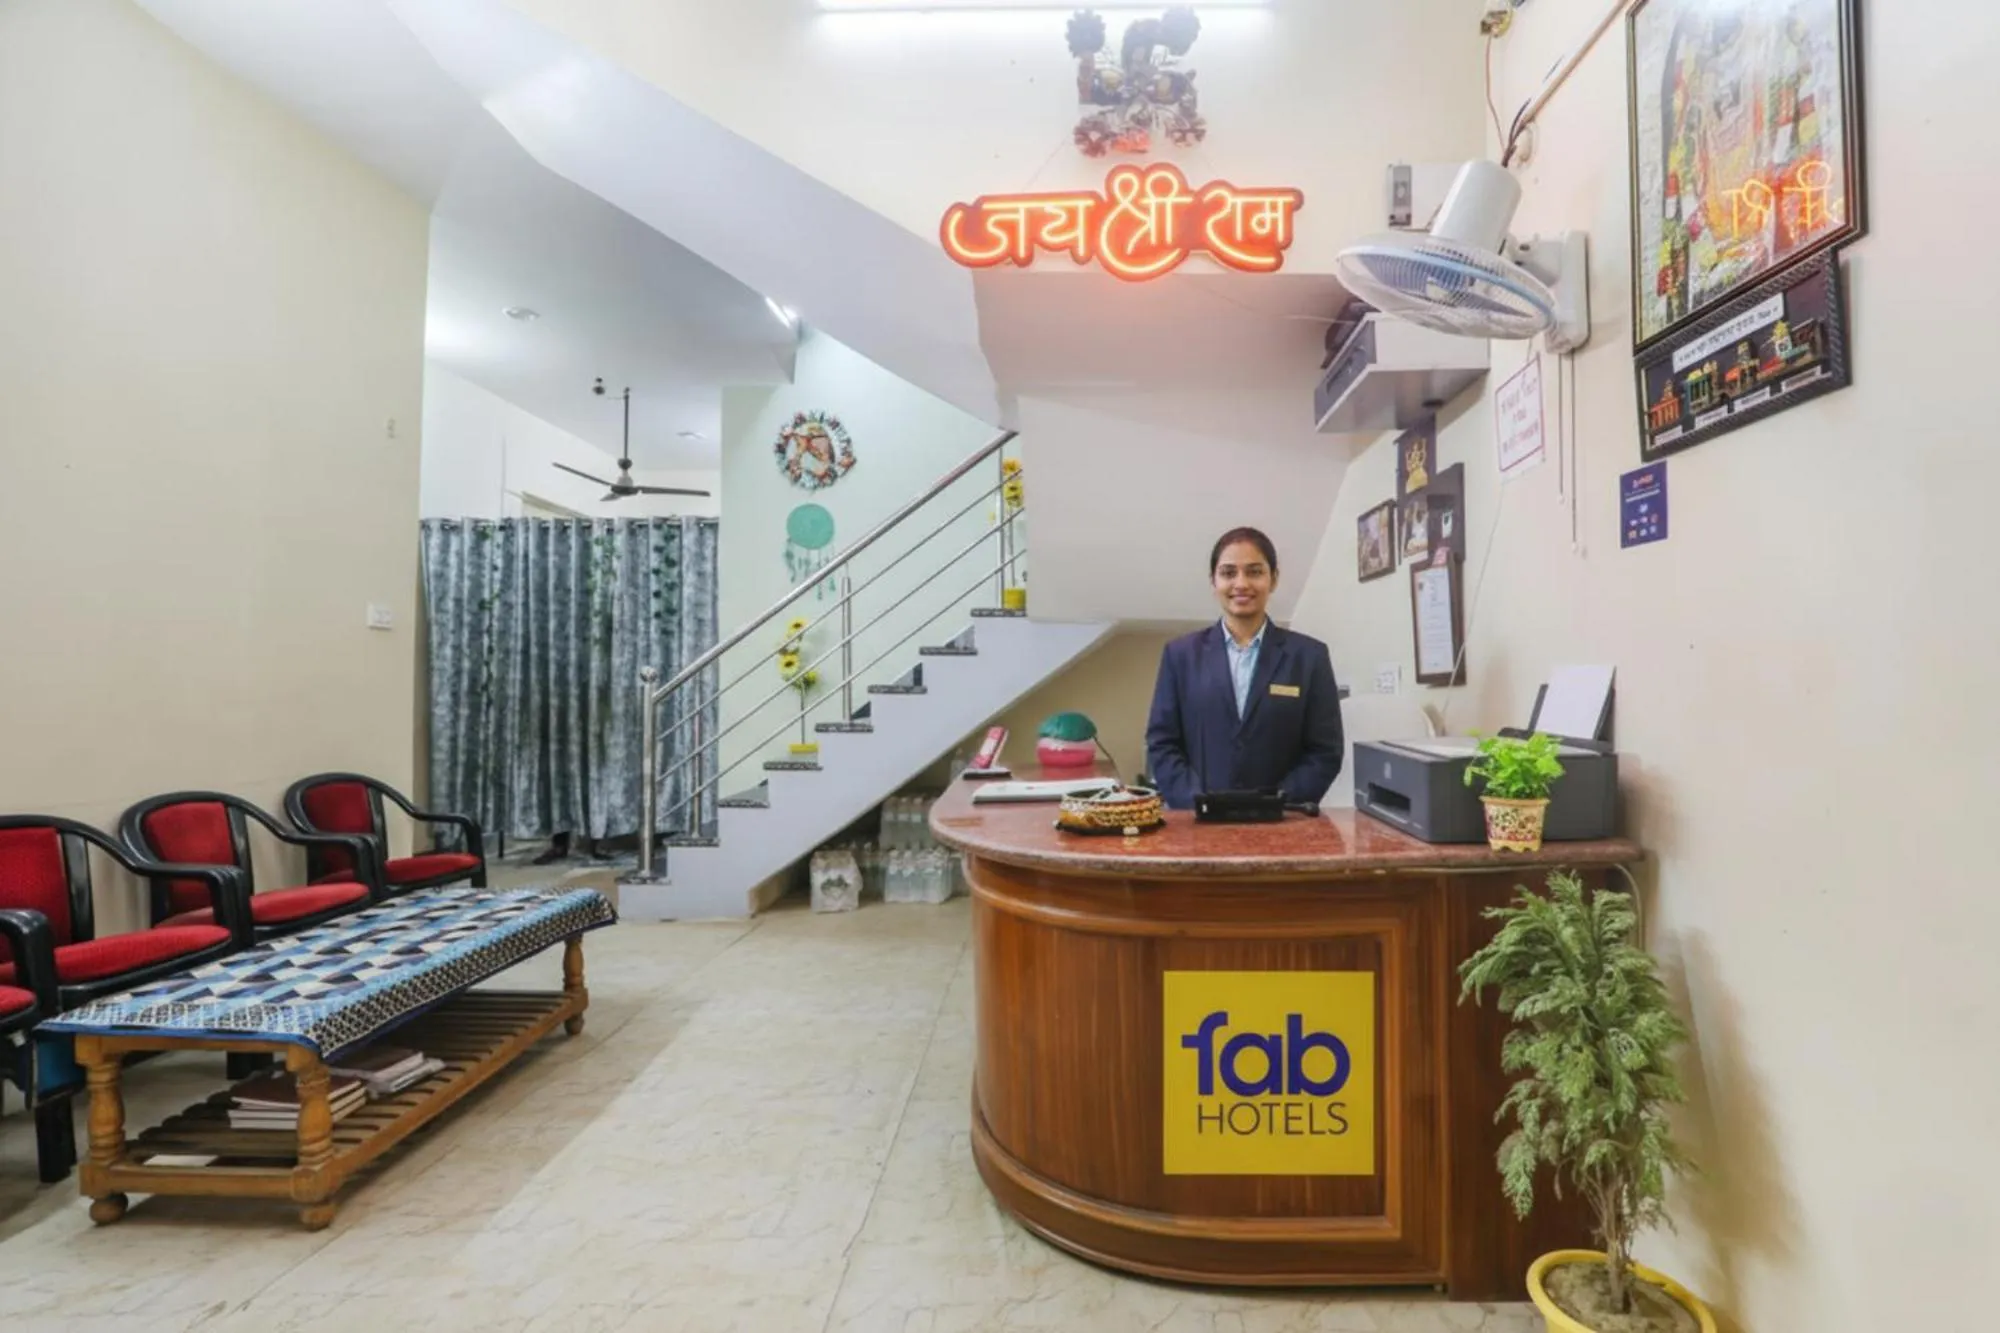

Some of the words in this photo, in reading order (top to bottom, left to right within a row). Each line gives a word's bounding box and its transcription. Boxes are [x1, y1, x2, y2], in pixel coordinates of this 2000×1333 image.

[946, 196, 1097, 260] जय
[1098, 169, 1196, 275] श्री
[1202, 187, 1297, 265] राम
[1181, 1010, 1351, 1097] fab
[1197, 1101, 1349, 1136] HOTELS
